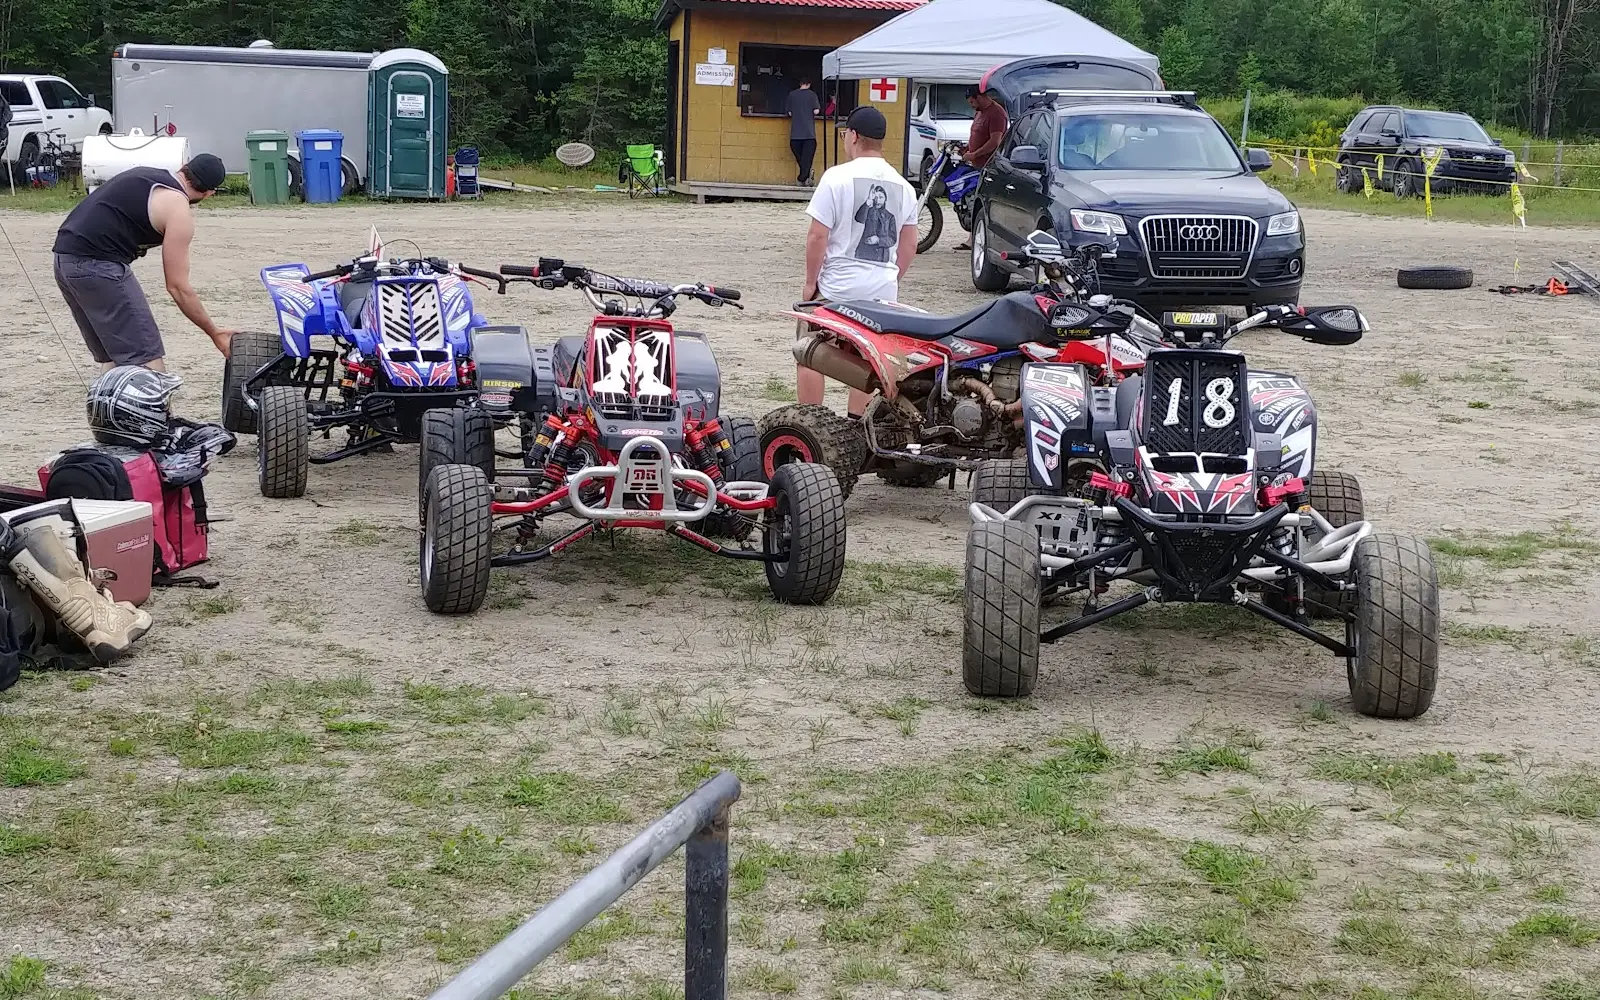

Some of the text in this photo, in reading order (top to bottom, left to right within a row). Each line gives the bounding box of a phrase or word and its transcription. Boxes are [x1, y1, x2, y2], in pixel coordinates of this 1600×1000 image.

[596, 281, 663, 295] RENTHAL
[284, 289, 316, 310] YAMAHA
[837, 305, 883, 332] HONDA
[1174, 312, 1216, 324] PROTAPER
[1111, 342, 1145, 360] HONDA
[1032, 369, 1069, 385] 18
[1042, 391, 1081, 421] YAMAHA
[1163, 377, 1236, 428] 18
